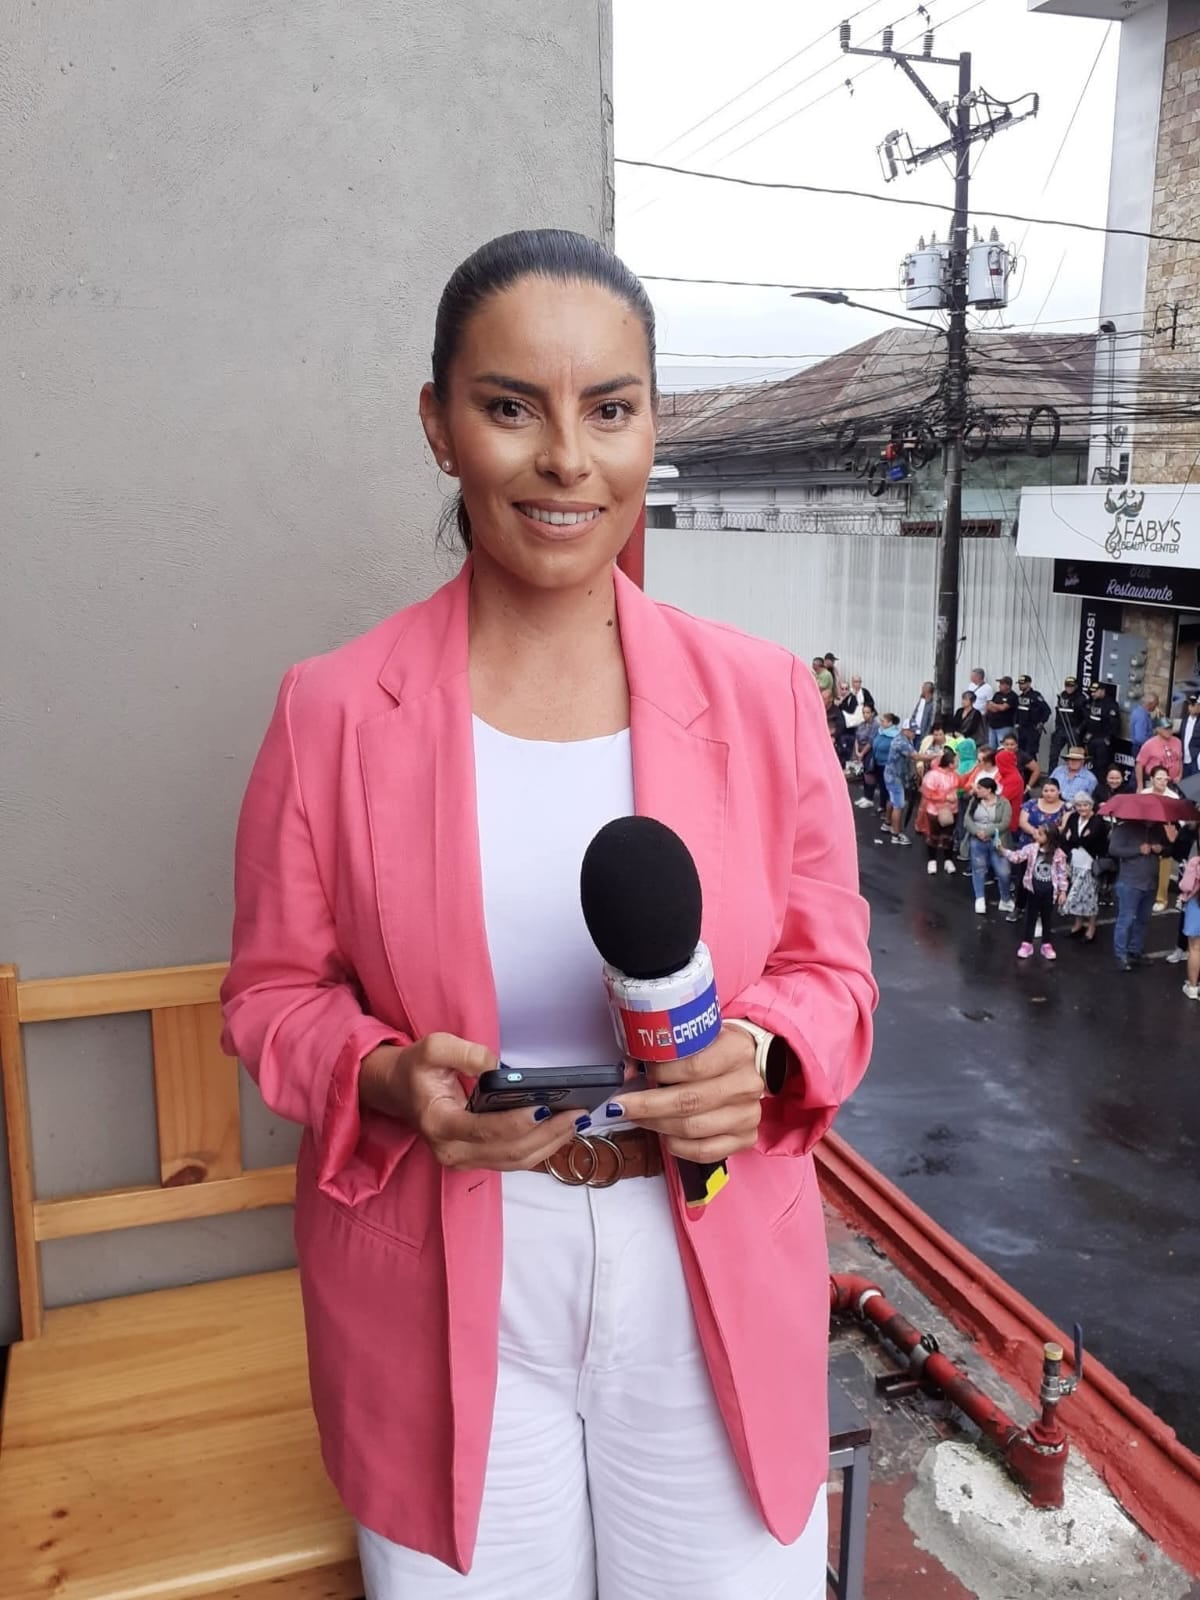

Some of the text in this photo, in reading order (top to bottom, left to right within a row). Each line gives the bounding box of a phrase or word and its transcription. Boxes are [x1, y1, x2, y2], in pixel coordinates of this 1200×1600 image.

[1124, 519, 1181, 543] FABY'S
[1121, 541, 1180, 554] BEAUTY CENTER
[1106, 578, 1174, 601] Restaurante
[638, 1029, 654, 1047] TV
[673, 1002, 717, 1044] CARTAGO
